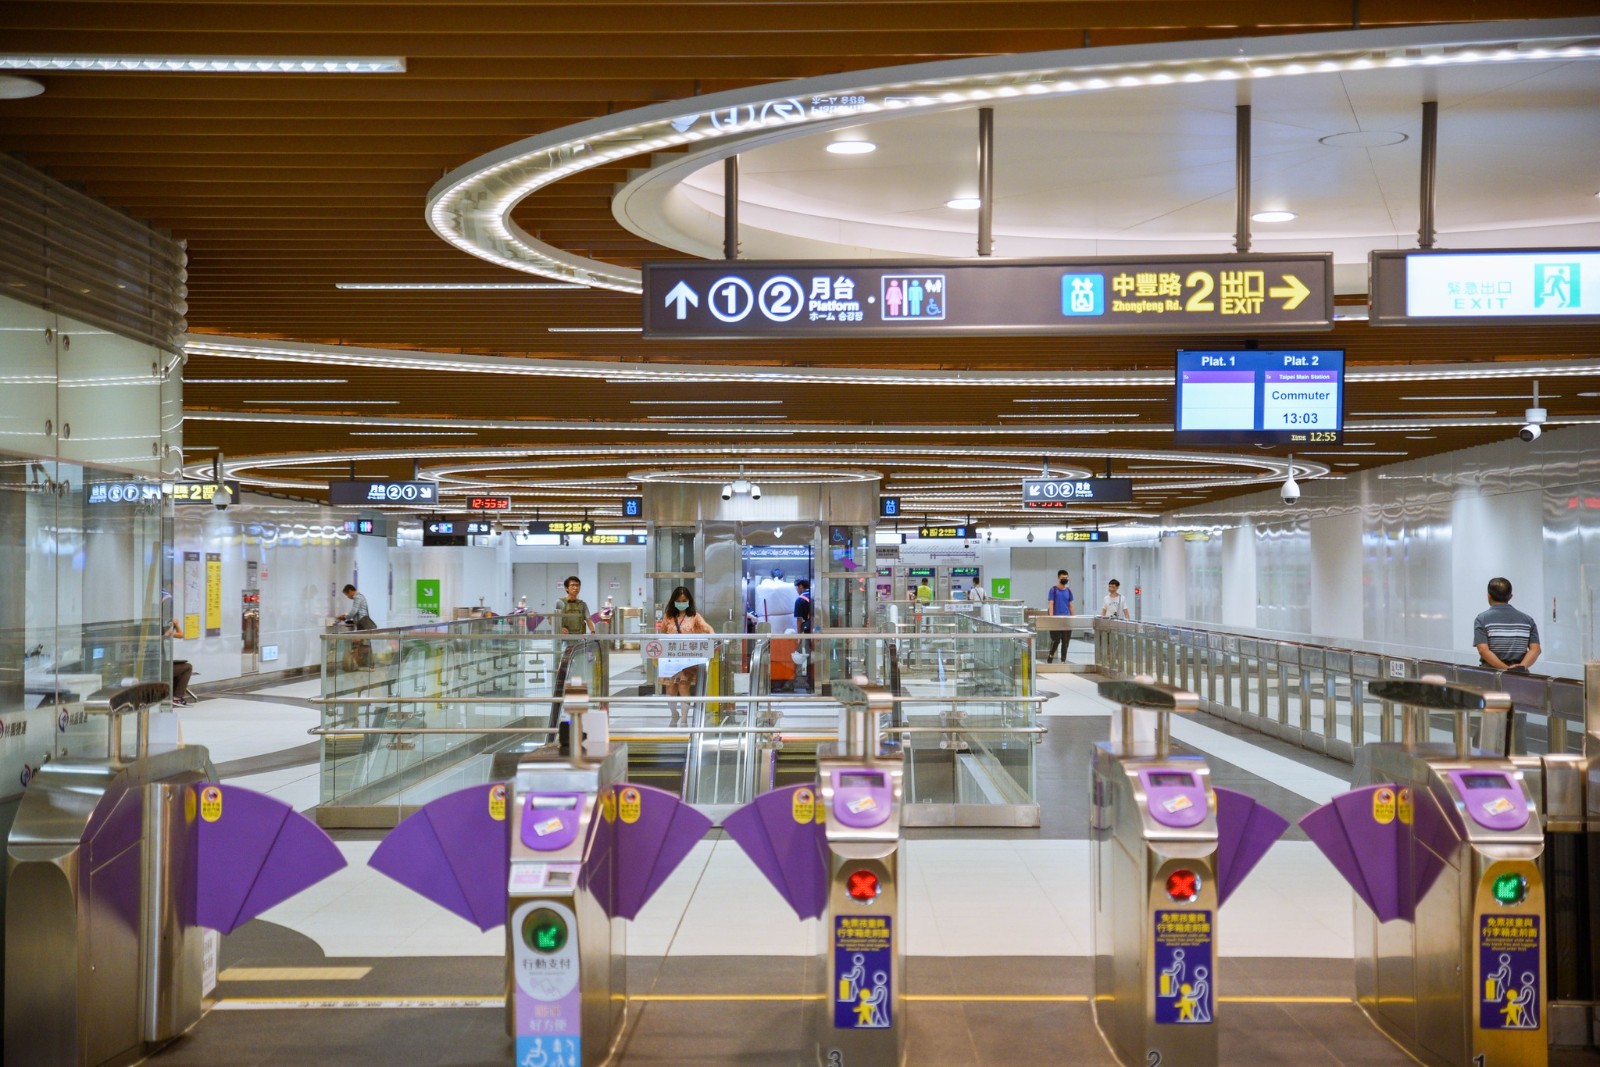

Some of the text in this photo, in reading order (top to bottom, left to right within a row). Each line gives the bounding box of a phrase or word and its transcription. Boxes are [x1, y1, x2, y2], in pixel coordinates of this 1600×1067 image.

[808, 276, 855, 300] 月台
[1112, 273, 1182, 297] 中豐路
[1220, 271, 1265, 298] 出口
[1448, 281, 1512, 295] 緊急出口
[1186, 271, 1214, 312] 2
[808, 300, 860, 312] Platform
[1112, 299, 1182, 313] Zhongfeng Rd.
[1220, 298, 1264, 314] EXIT
[1454, 298, 1508, 310] EXIT
[1202, 356, 1236, 366] Plat. 1
[1284, 356, 1319, 366] Plat. 2
[1272, 390, 1330, 400] Commuter
[1282, 413, 1318, 424] 13:03
[1310, 432, 1336, 442] 12:55
[190, 484, 202, 500] 2
[472, 498, 496, 508] 12:55
[668, 642, 708, 652] 禁止攀爬
[522, 958, 571, 970] 行動支付
